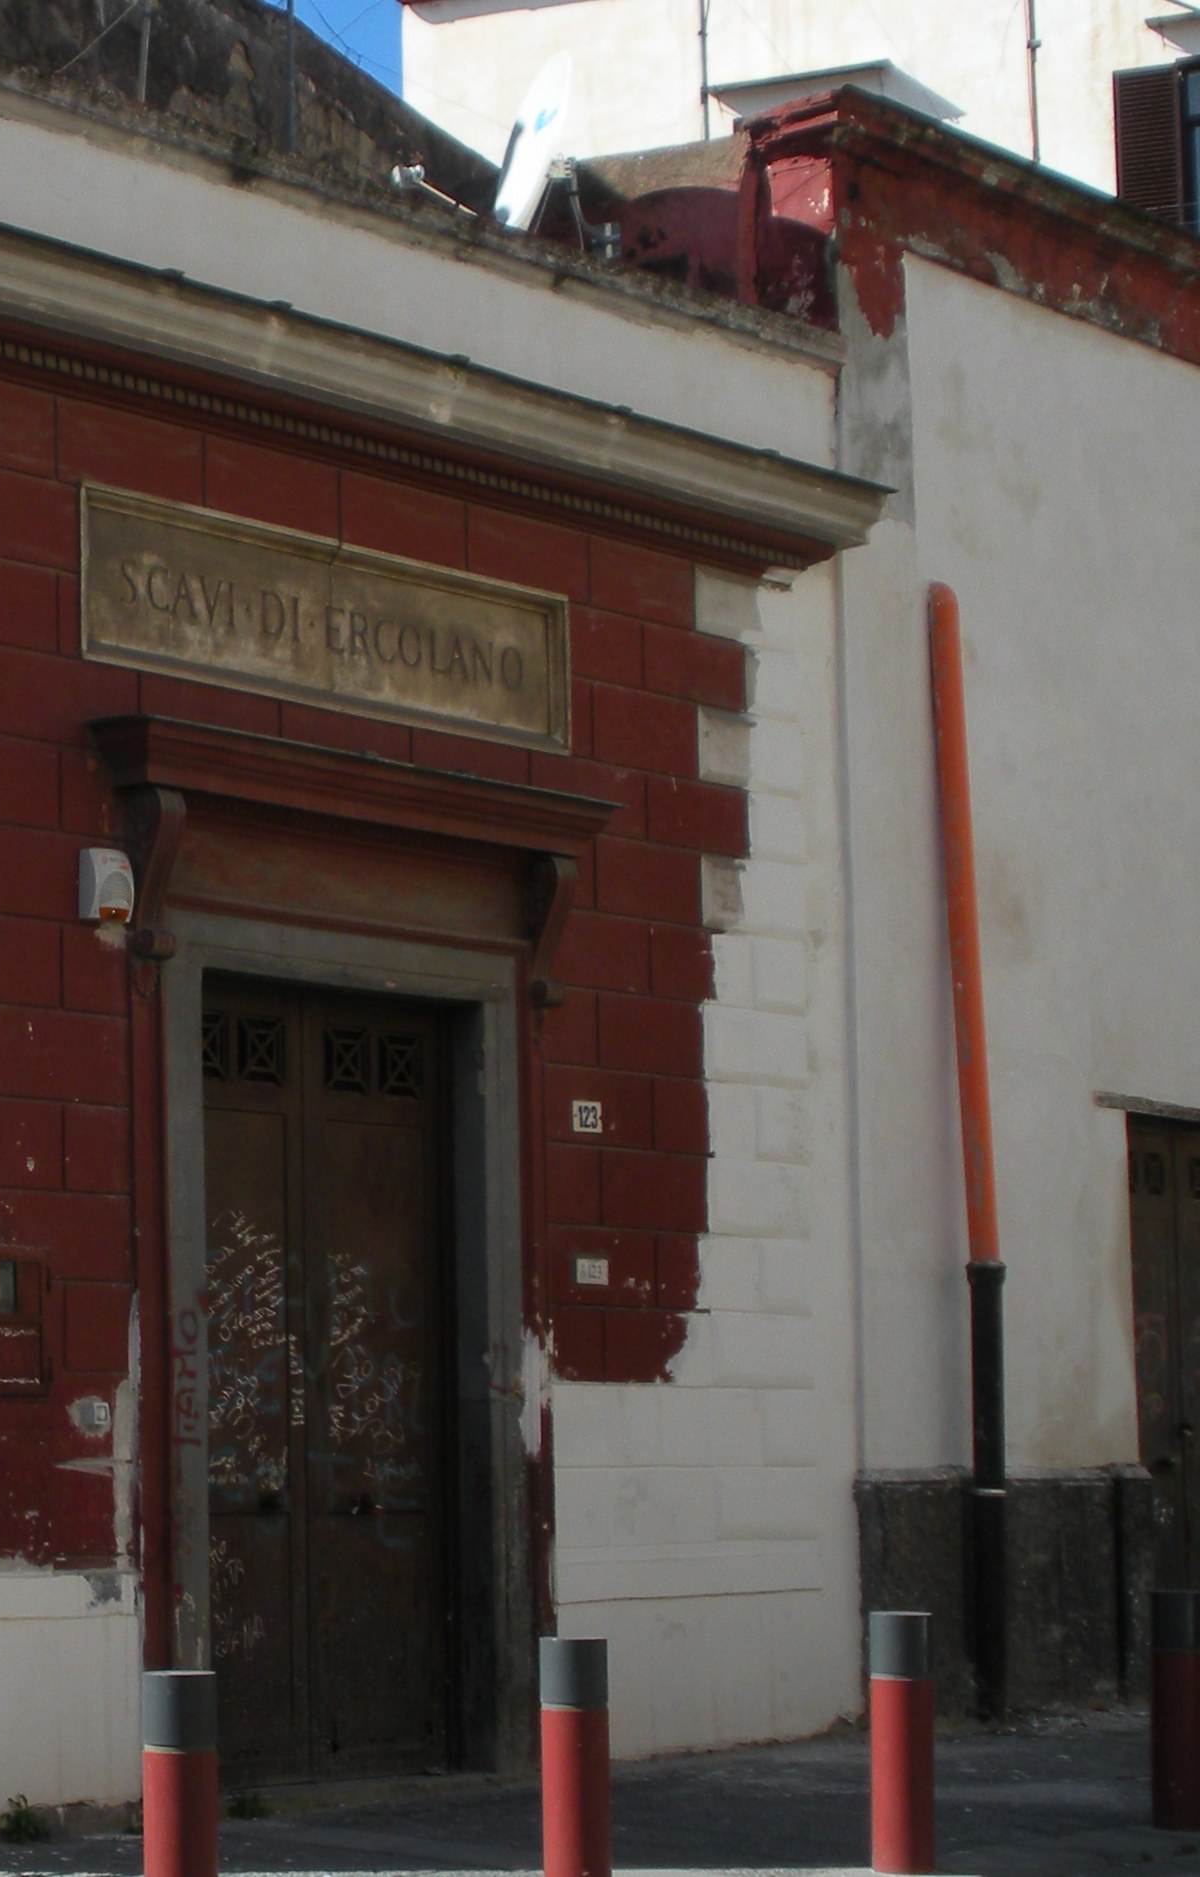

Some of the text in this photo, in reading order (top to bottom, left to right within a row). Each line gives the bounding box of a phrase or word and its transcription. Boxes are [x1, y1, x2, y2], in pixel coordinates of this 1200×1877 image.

[120, 558, 525, 692] SCAVI DI ERCOLANO
[577, 1104, 600, 1130] 123
